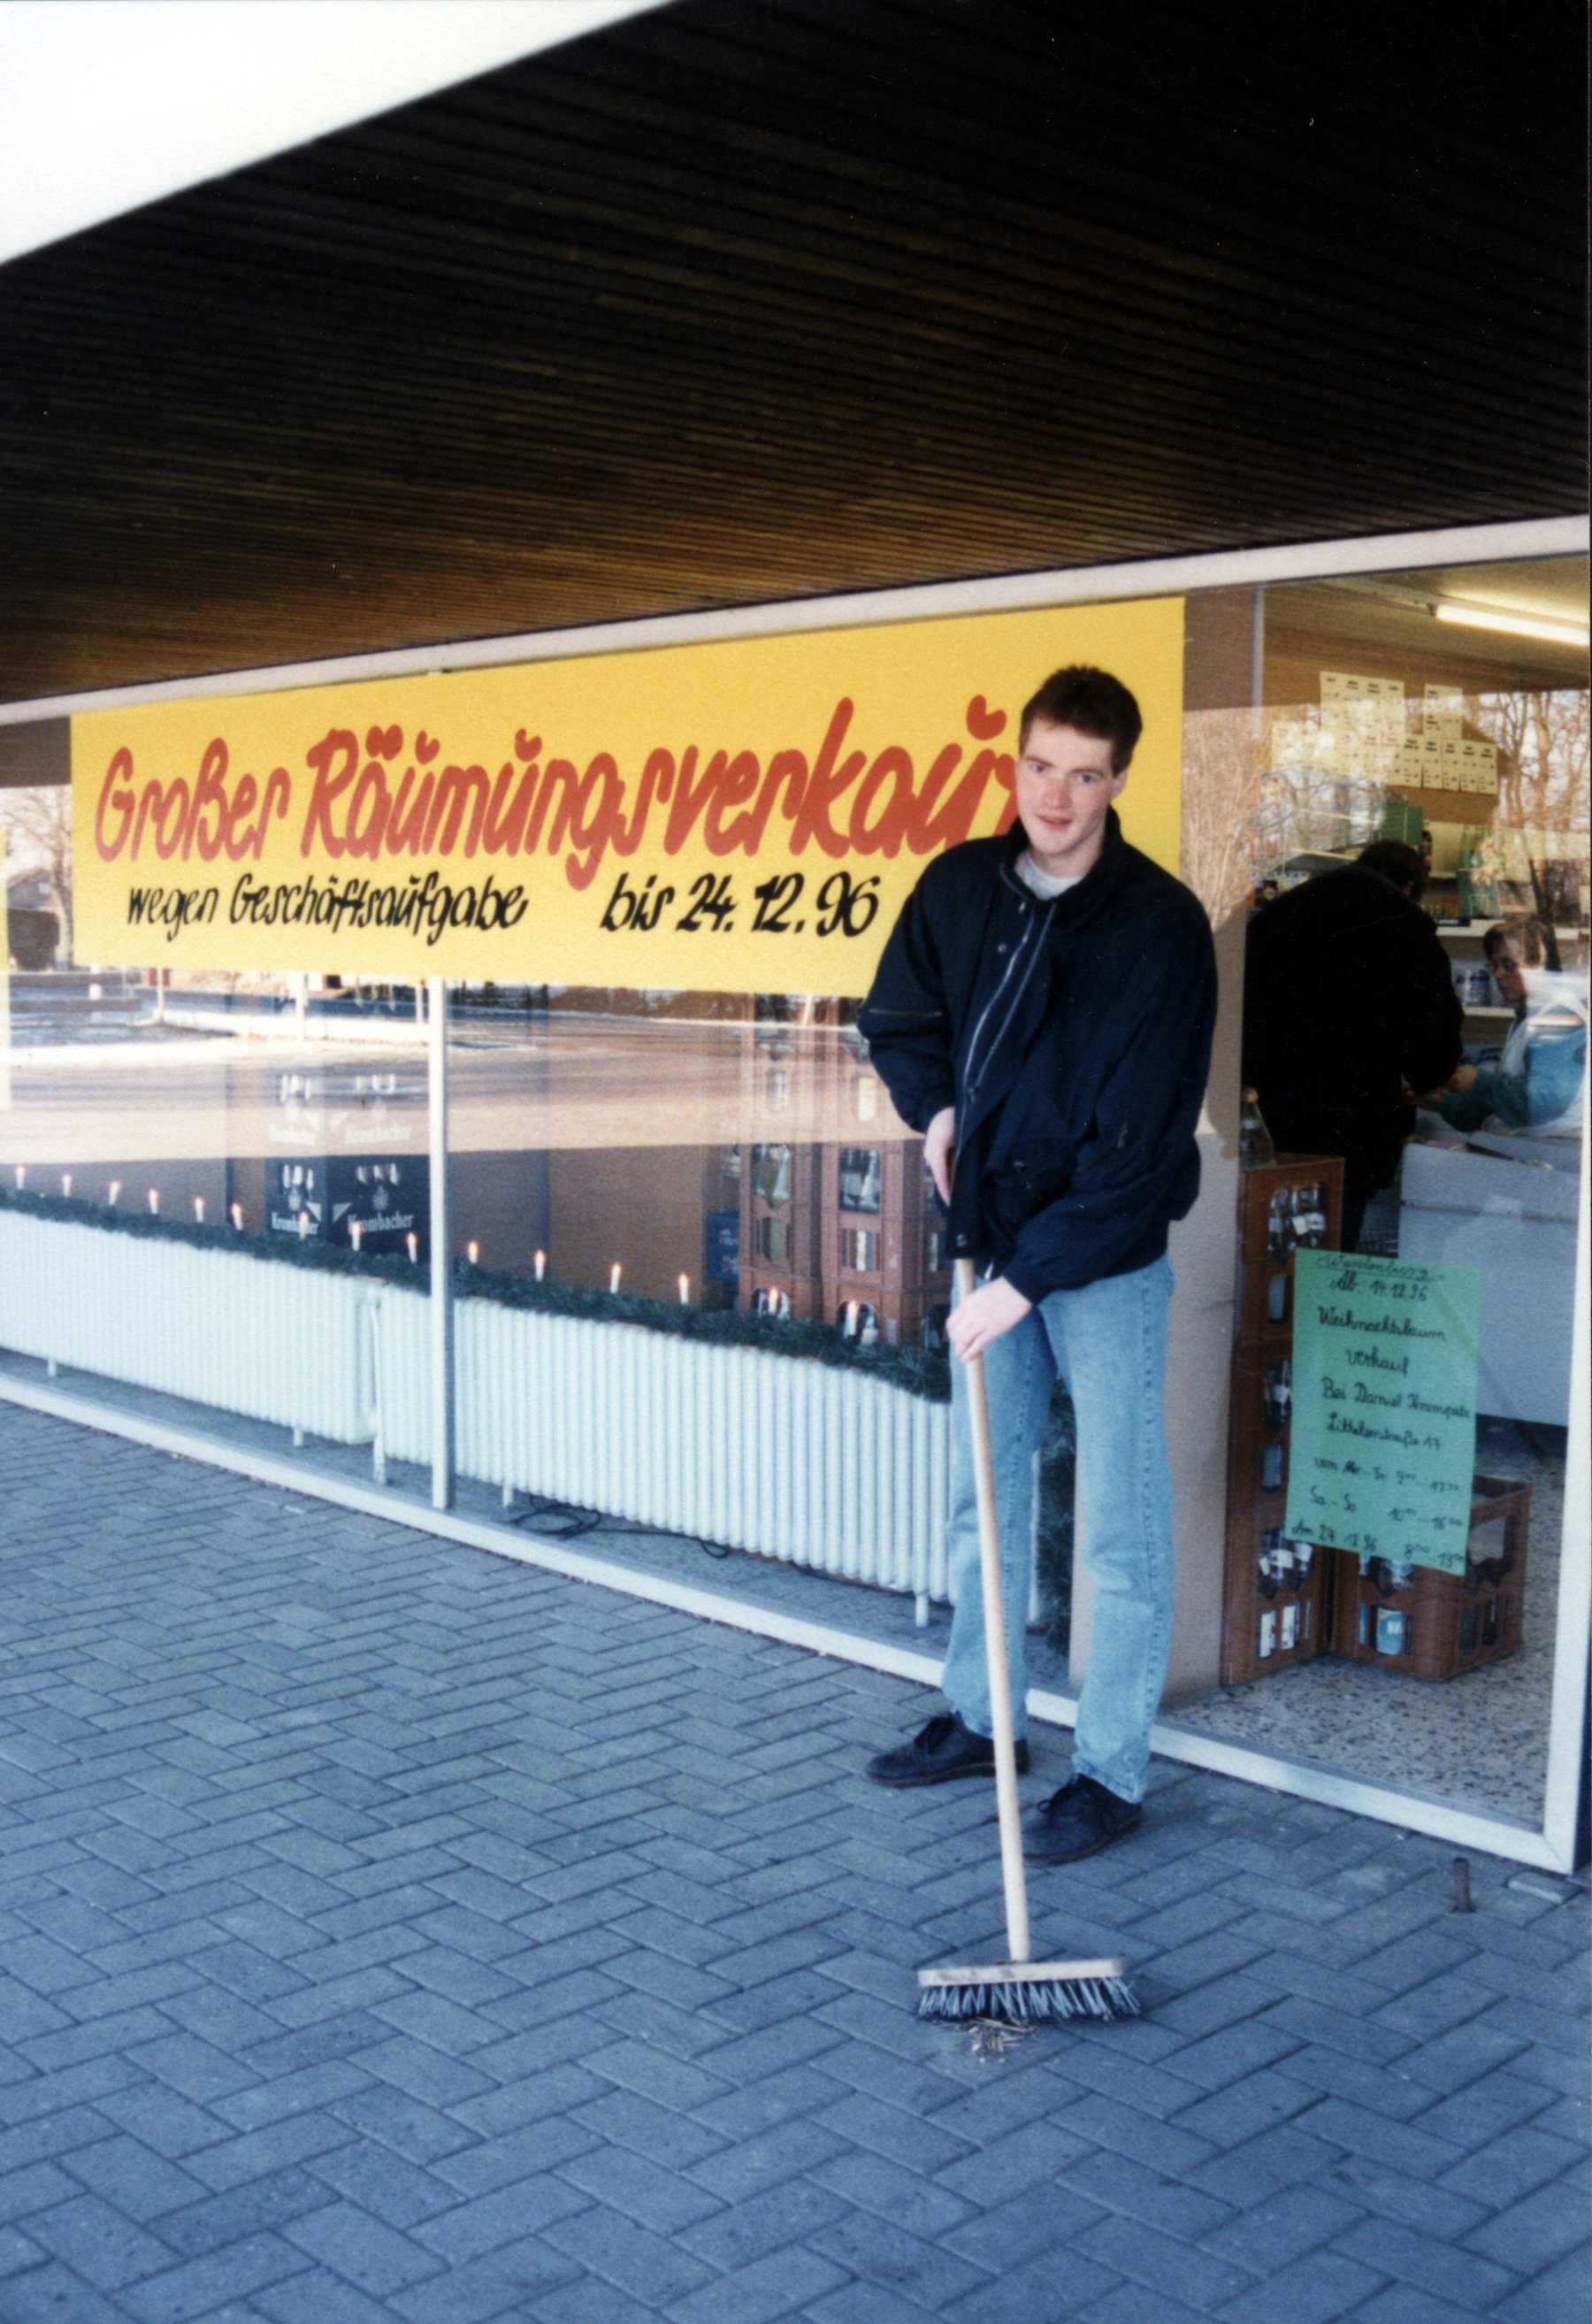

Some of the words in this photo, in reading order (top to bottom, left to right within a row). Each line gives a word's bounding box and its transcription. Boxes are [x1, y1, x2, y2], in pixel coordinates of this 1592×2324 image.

[96, 738, 292, 863] Großer
[127, 886, 216, 940] wegen
[229, 871, 529, 946] Geschäftsaufgabe
[600, 872, 676, 933] bis
